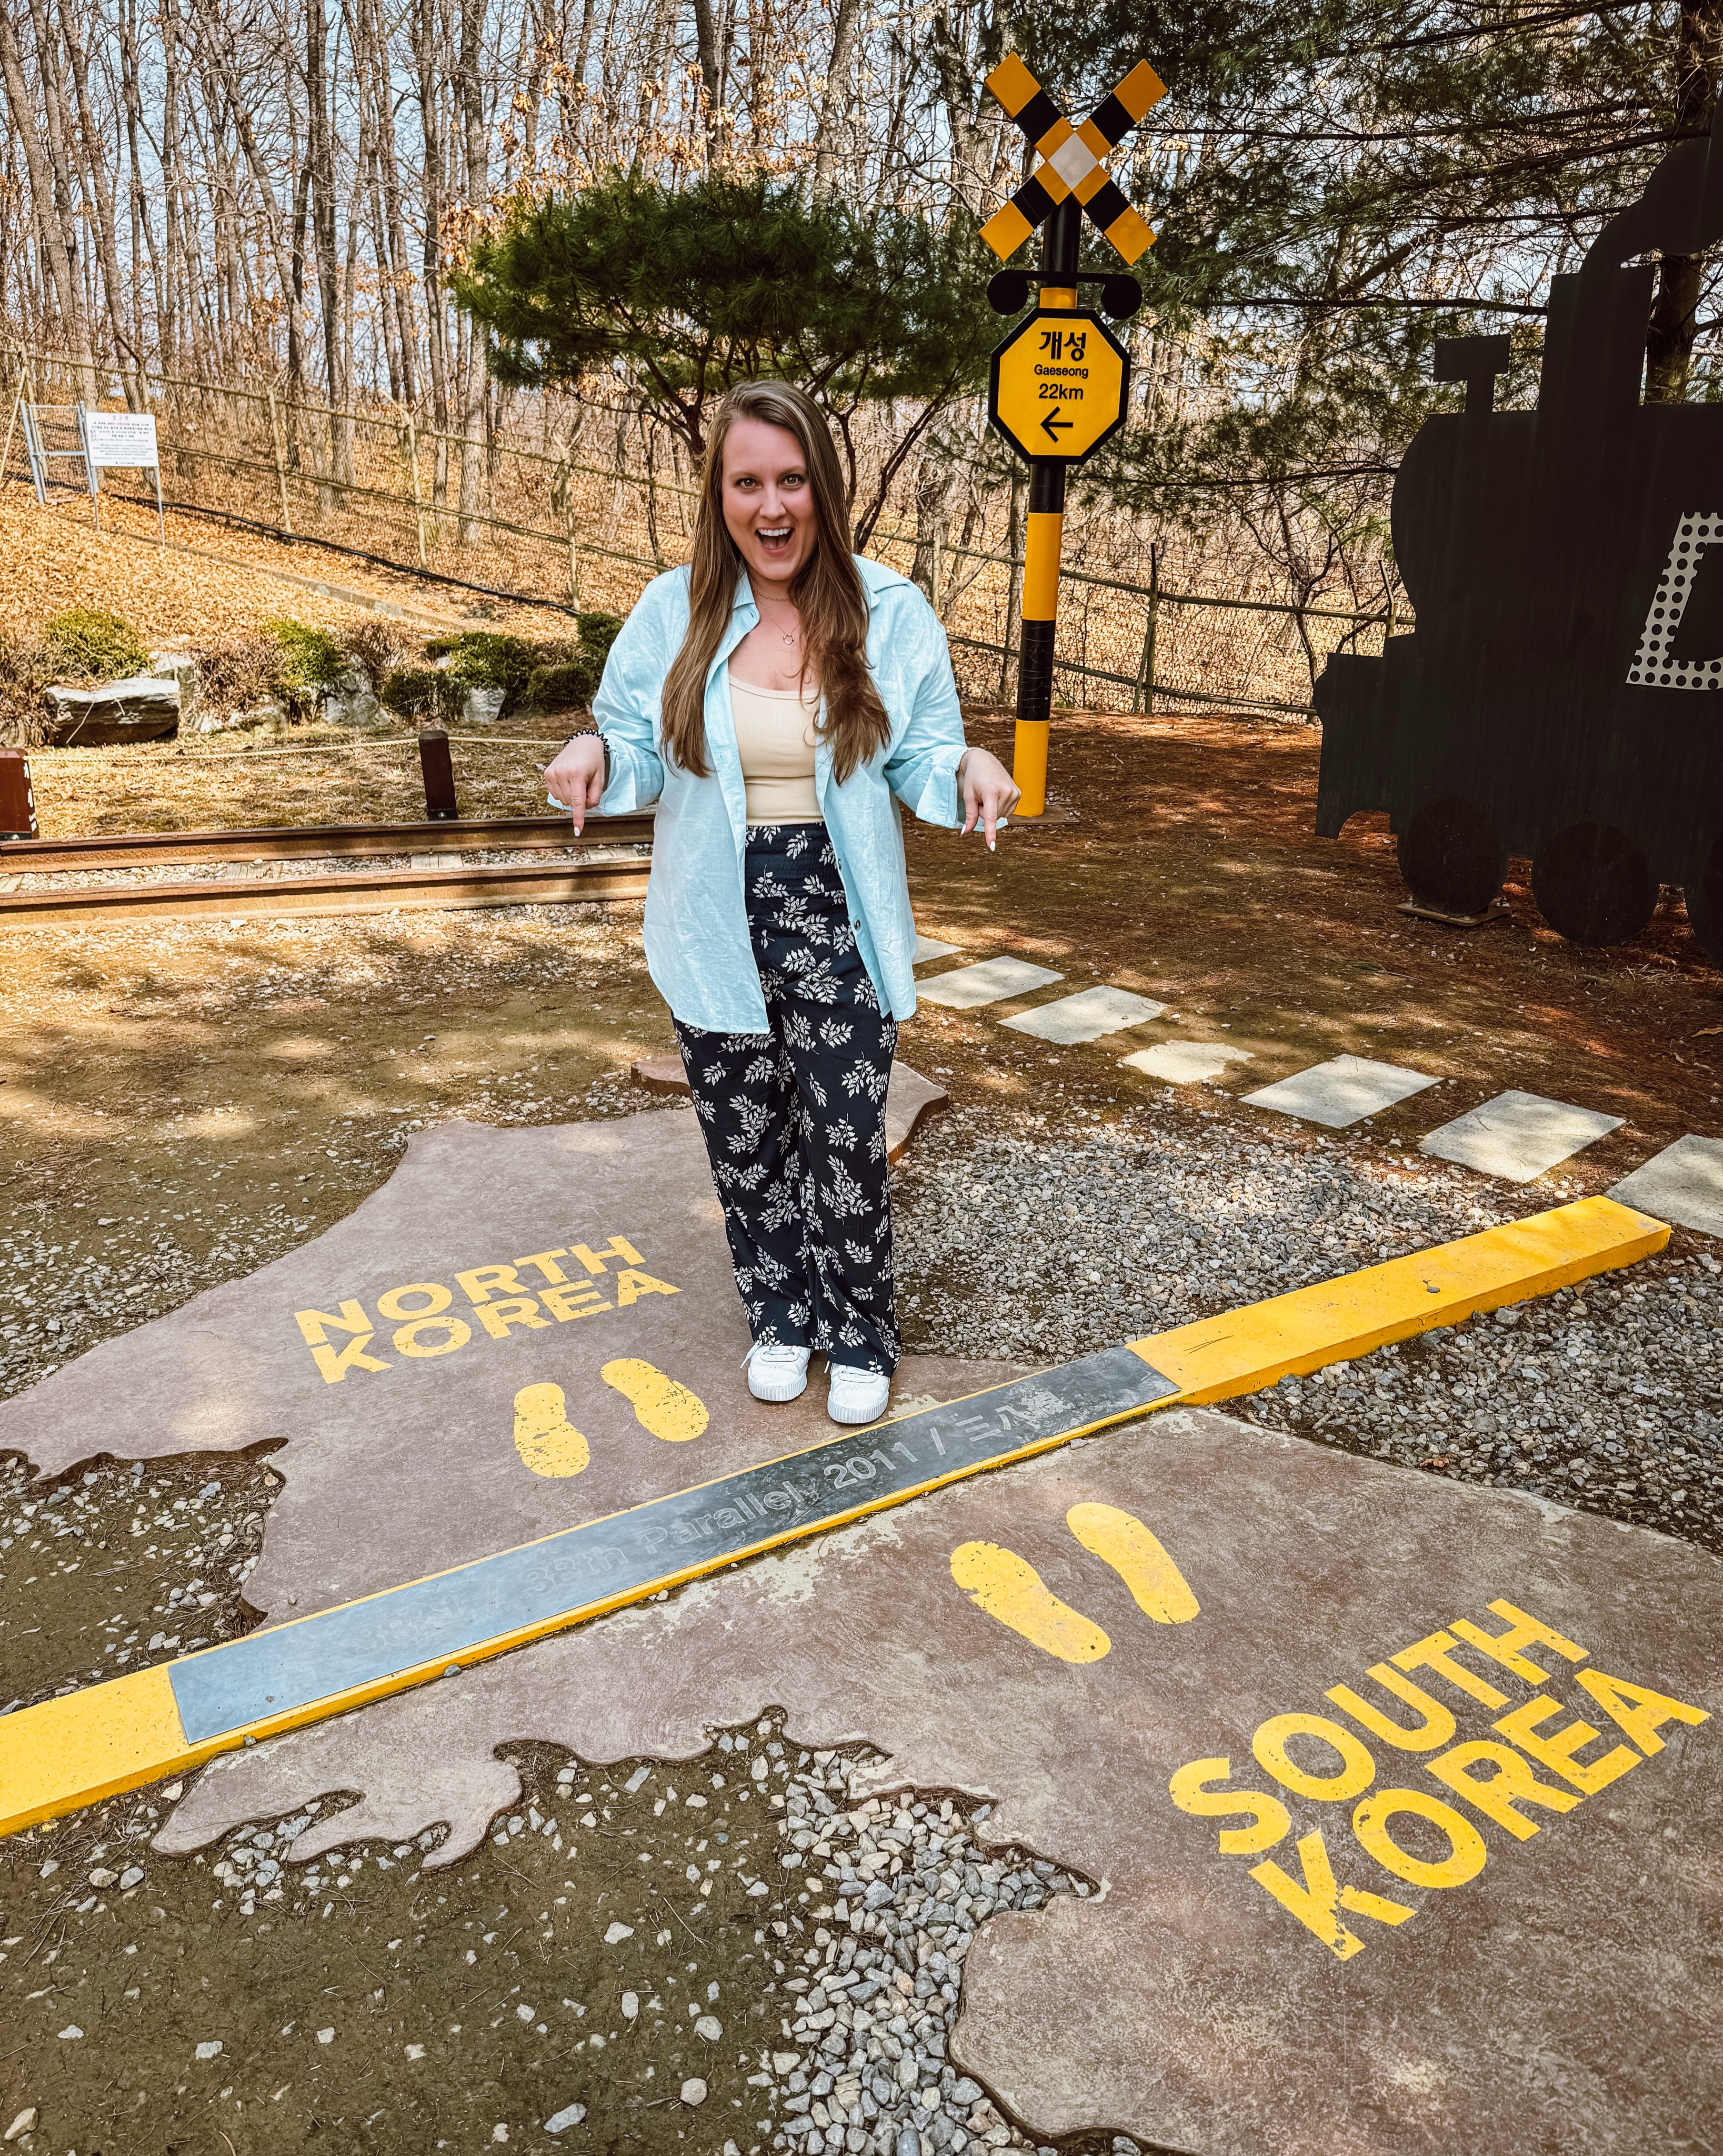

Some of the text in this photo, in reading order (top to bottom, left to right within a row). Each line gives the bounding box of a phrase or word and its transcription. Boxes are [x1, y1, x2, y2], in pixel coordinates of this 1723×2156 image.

[1034, 364, 1089, 379] Gaeseong
[1038, 331, 1087, 362] 개성
[1038, 383, 1084, 400] 22km
[294, 1234, 647, 1346] NORTH
[310, 1268, 684, 1384] KOREA
[526, 1545, 629, 1594] 38th
[823, 1441, 918, 1489] 2011
[1168, 1598, 1590, 1854] SOUTH
[1248, 1668, 1712, 1961] KOREA
